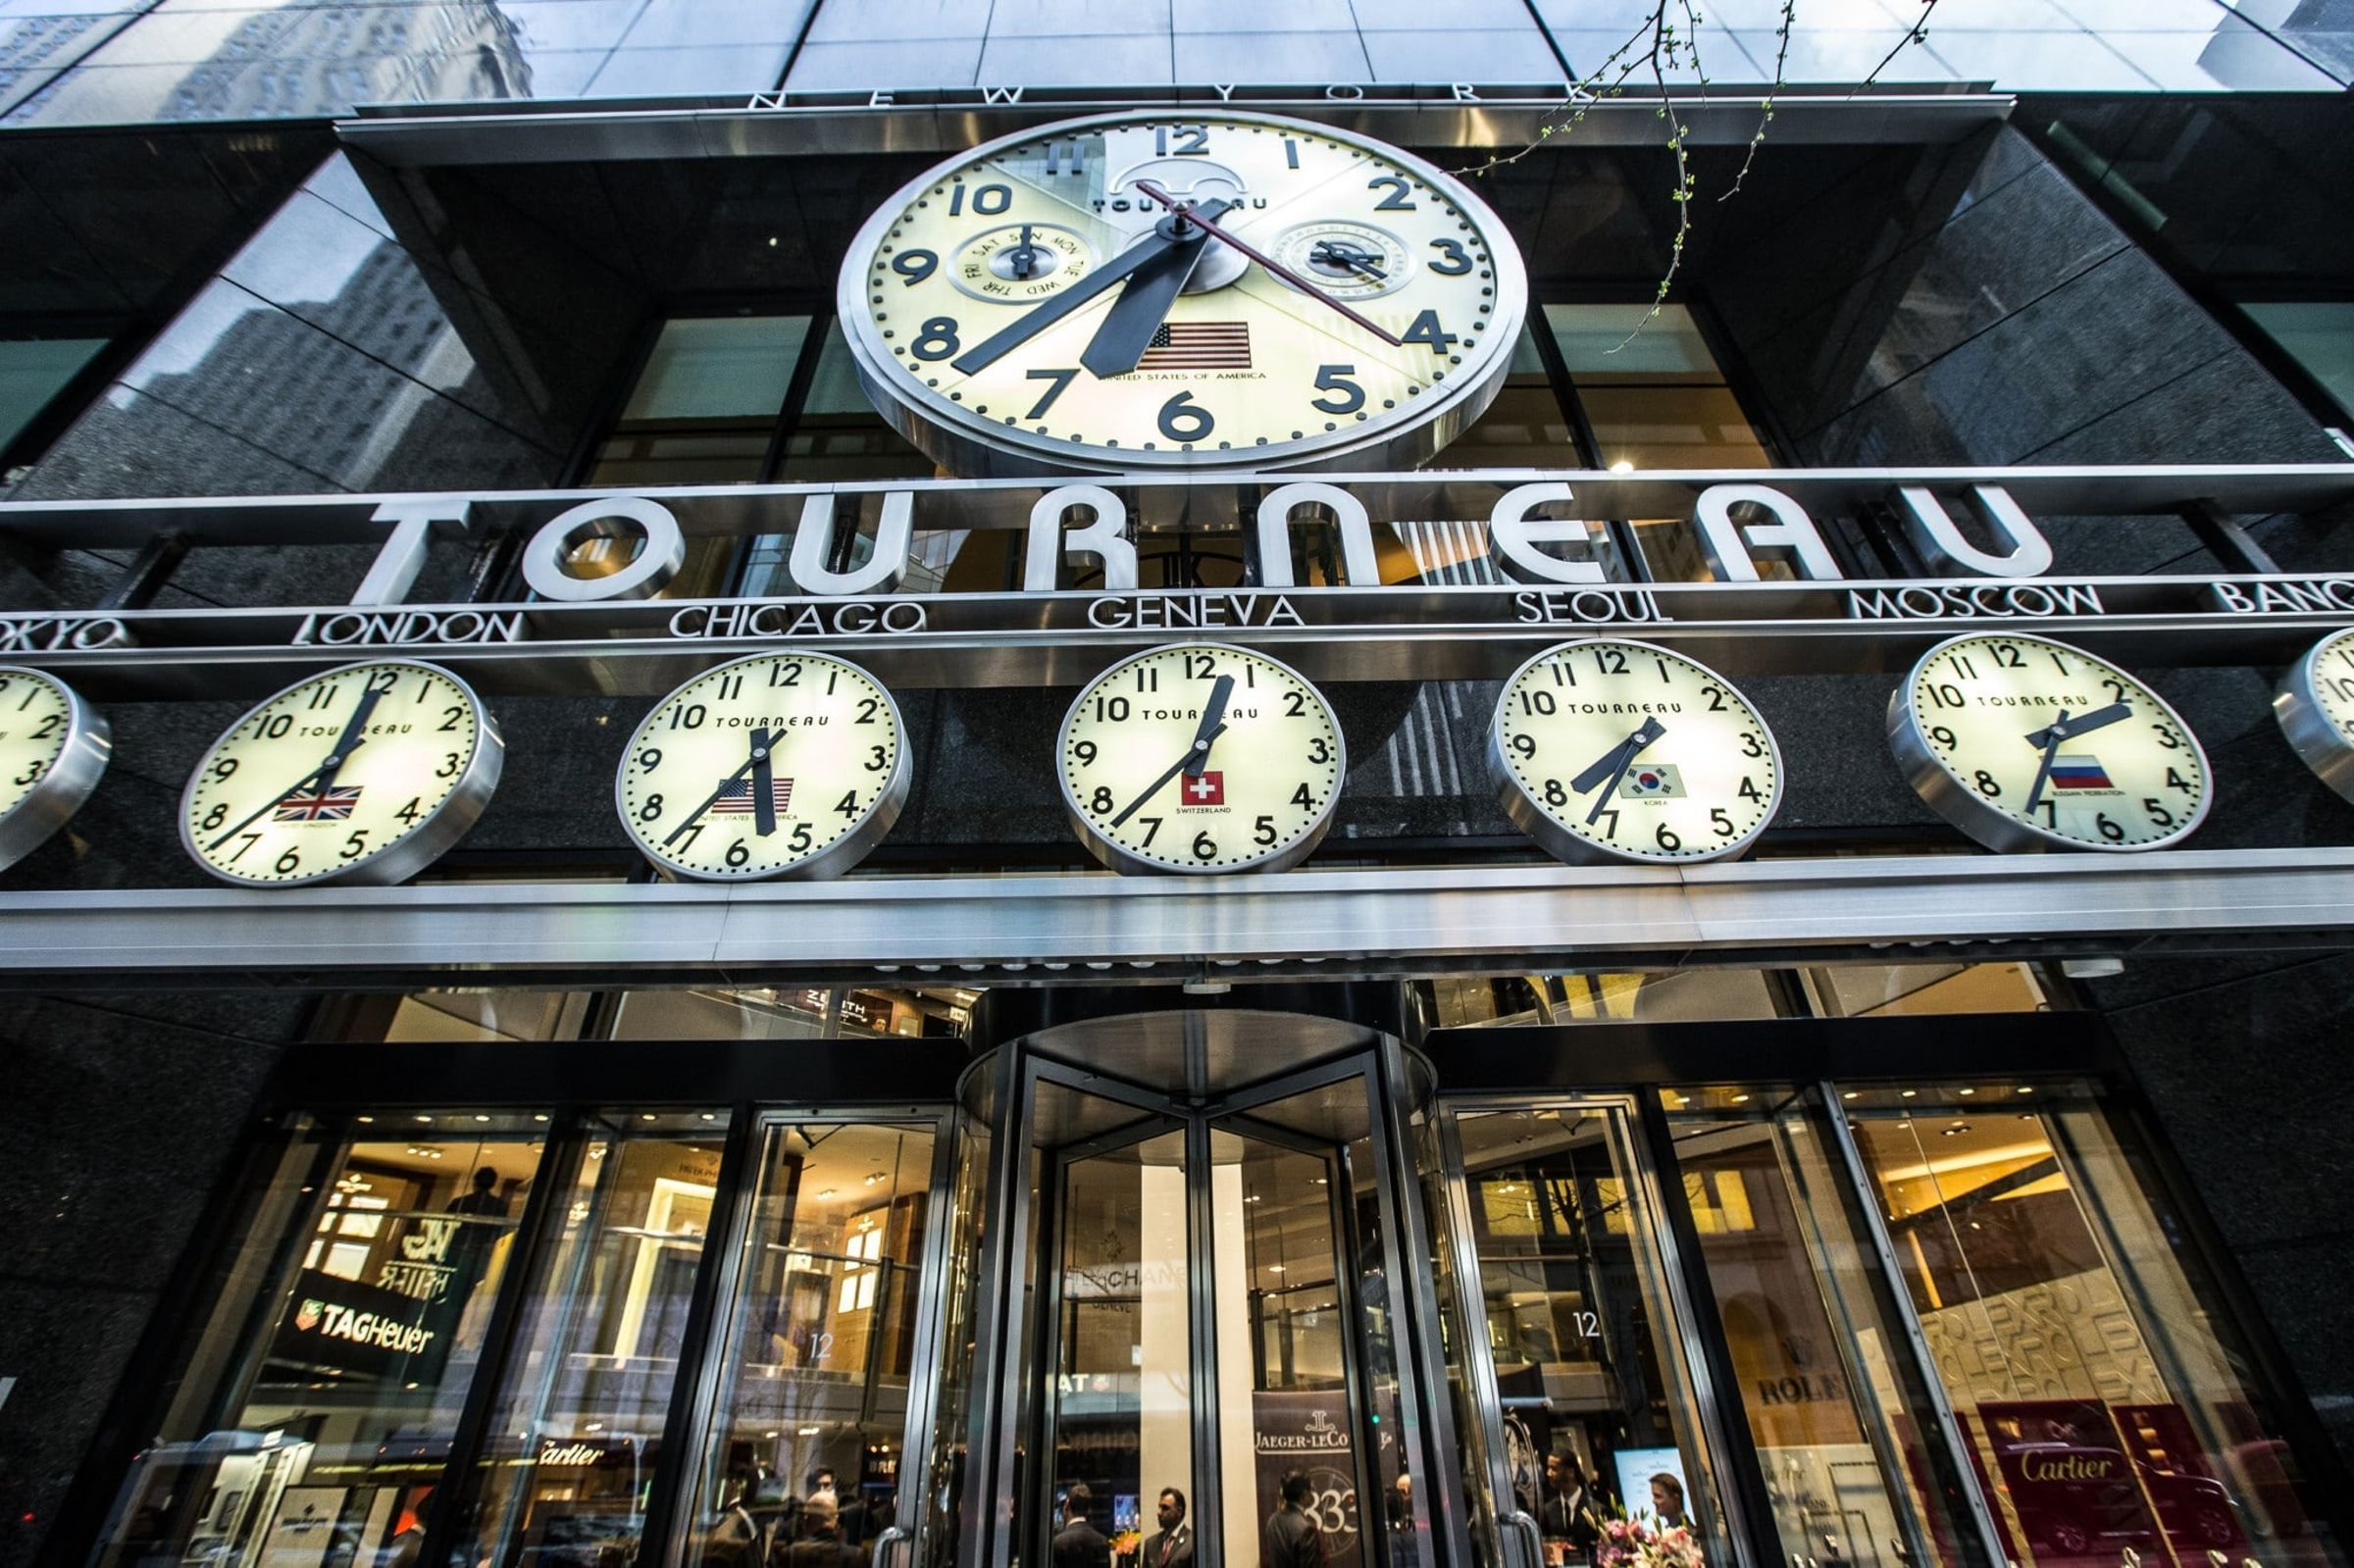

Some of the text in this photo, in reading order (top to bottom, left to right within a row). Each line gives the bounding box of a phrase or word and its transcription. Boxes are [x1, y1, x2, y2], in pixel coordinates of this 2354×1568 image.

[744, 81, 1595, 111] NEW YORK
[1155, 126, 1209, 156] 12
[1047, 141, 1082, 174] 11
[1285, 139, 1300, 170] 1
[949, 184, 1012, 217] 10
[1092, 197, 1267, 213] TOUAU
[1368, 177, 1417, 211] 2
[972, 238, 1000, 257] SAT
[1052, 236, 1080, 255] MON
[1428, 238, 1473, 277] 3
[892, 249, 939, 287] 9
[964, 263, 983, 279] FRI
[910, 317, 960, 362] 8
[1403, 310, 1457, 355] 4
[1147, 372, 1189, 381] STATES
[1194, 372, 1209, 380] OF
[1215, 371, 1267, 380] AMERICA
[1025, 369, 1081, 420] 7
[1311, 365, 1365, 415] 5
[1157, 390, 1214, 442] 6
[358, 482, 2052, 604] TOURNEAU
[1088, 594, 1305, 629] GENEVA
[1516, 590, 1673, 623] SEOUL
[1849, 584, 2105, 618] MOSCOW
[292, 611, 526, 645] LONDON
[670, 602, 927, 636] CHICAGO
[1186, 656, 1216, 679] 12
[1595, 650, 1630, 674] 12
[1949, 656, 1977, 679] 11
[1988, 644, 2026, 667] 12
[2049, 652, 2069, 676] 1
[363, 673, 398, 694] 12
[769, 663, 802, 685] 12
[827, 672, 838, 695] 1
[1138, 668, 1156, 692] 11
[1248, 665, 1254, 687] 1
[1552, 663, 1576, 686] 11
[1656, 659, 1669, 683] 1
[18, 687, 42, 711] 1
[309, 686, 337, 709] 11
[417, 680, 432, 703] 1
[718, 676, 742, 699] 11
[1701, 686, 1727, 711] 2
[1926, 684, 1965, 708] 10
[2103, 680, 2131, 703] 2
[855, 699, 877, 724] 2
[1097, 697, 1129, 722] 10
[1283, 691, 1305, 717] 2
[1520, 690, 1556, 716] 10
[1568, 703, 1681, 714] TOURNEAU
[1977, 695, 2088, 707] TOURNEAU
[29, 715, 60, 739] 2
[252, 714, 293, 739] 10
[437, 706, 463, 731] 2
[670, 705, 706, 730] 10
[716, 716, 829, 728] TOURNEAU
[1142, 709, 1257, 720] TOURAU
[299, 725, 412, 736] TOUEAU
[1932, 727, 1957, 751] 9
[2153, 725, 2177, 749] 3
[864, 745, 886, 771] 3
[1074, 741, 1097, 767] 9
[1307, 738, 1329, 764] 3
[1512, 734, 1536, 760] 9
[1740, 733, 1763, 758] 3
[15, 761, 43, 785] 3
[215, 760, 237, 784] 9
[435, 753, 459, 778] 3
[640, 748, 662, 775] 9
[1545, 780, 1567, 807] 8
[1738, 777, 1763, 803] 4
[1974, 770, 2001, 797] 8
[2167, 768, 2189, 793] 4
[640, 793, 663, 822] 8
[834, 790, 859, 818] 4
[1092, 786, 1113, 814] 8
[1290, 783, 1316, 811] 4
[202, 803, 229, 831] 8
[394, 797, 420, 825] 4
[1599, 810, 1618, 838] 7
[1711, 808, 1734, 836] 5
[2038, 801, 2055, 828] 7
[2144, 798, 2173, 826] 5
[679, 825, 703, 854] 7
[788, 823, 812, 852] 5
[1140, 818, 1163, 847] 7
[1254, 816, 1277, 845] 5
[1656, 822, 1681, 851] 6
[2096, 813, 2124, 840] 6
[230, 834, 262, 862] 7
[339, 830, 369, 859] 5
[726, 837, 749, 867] 6
[1193, 831, 1217, 860] 6
[275, 846, 299, 874] 6
[1572, 1312, 1601, 1338] 12
[811, 1334, 834, 1359] 12
[2021, 1449, 2113, 1482] Cartier
